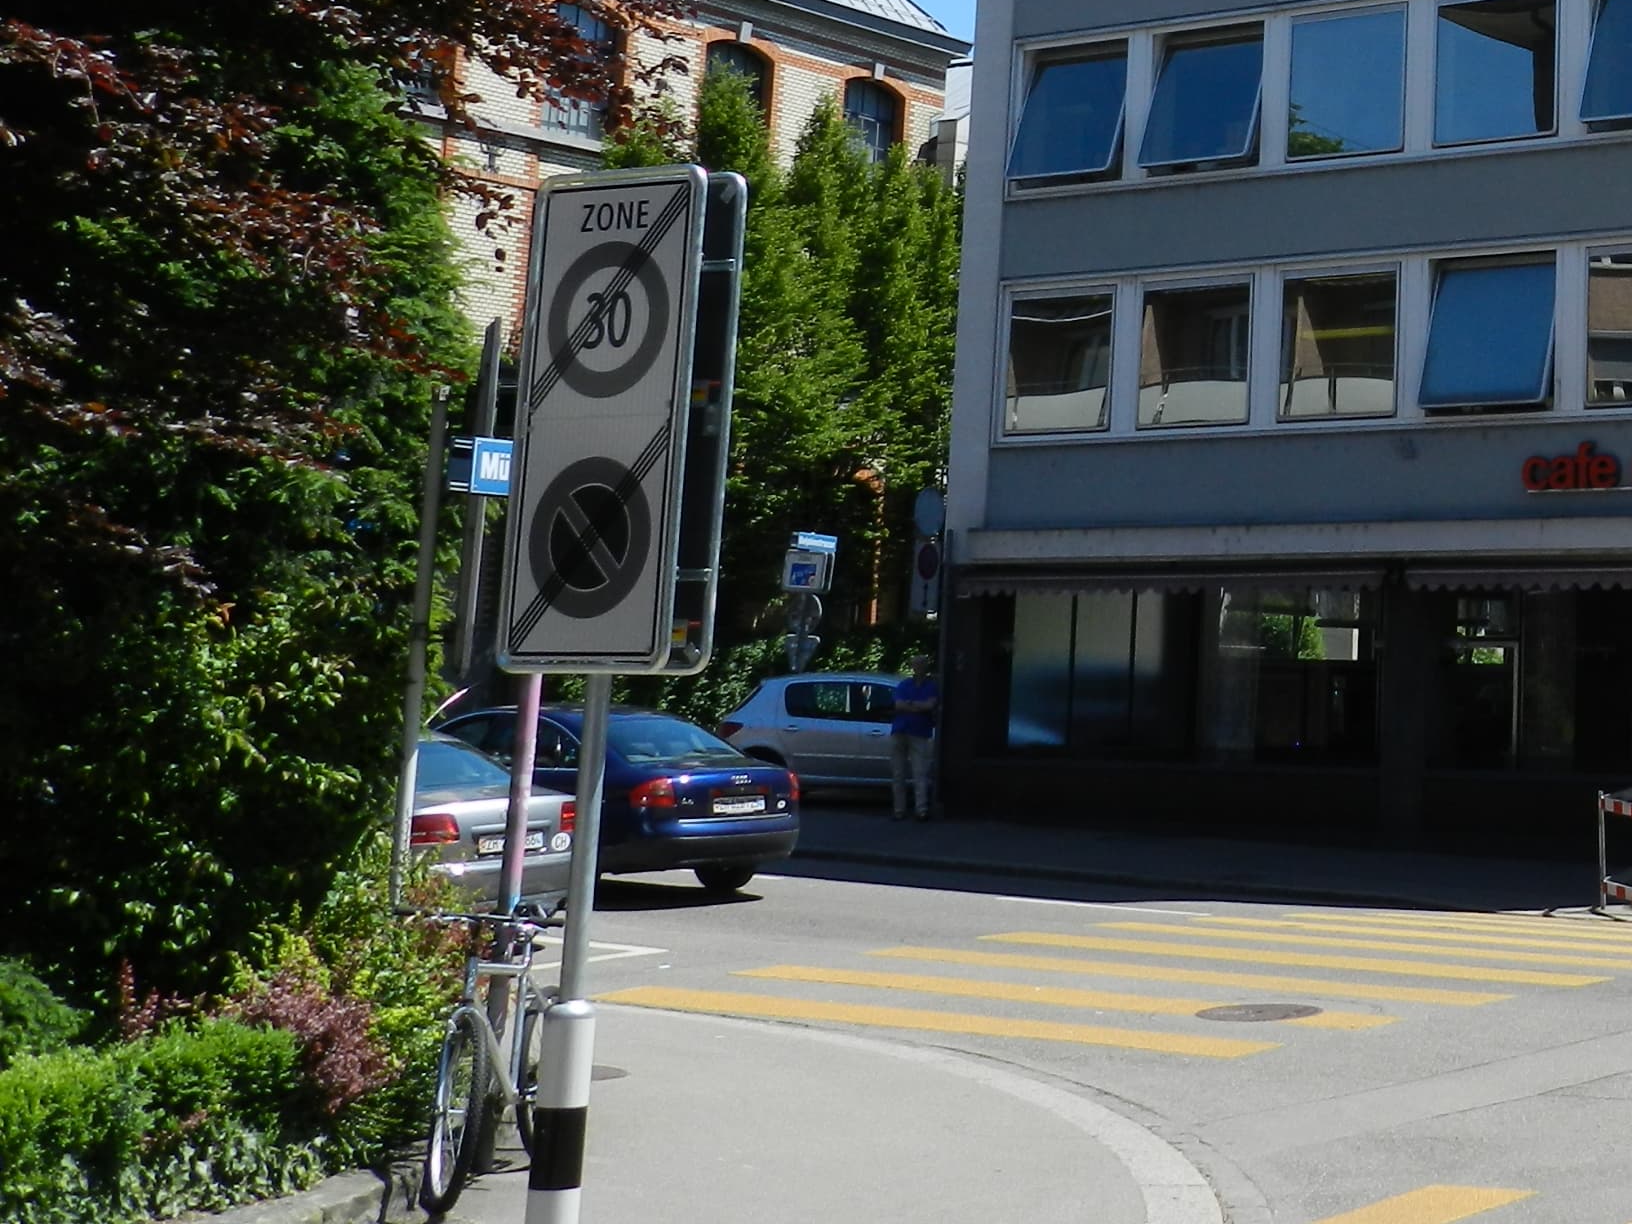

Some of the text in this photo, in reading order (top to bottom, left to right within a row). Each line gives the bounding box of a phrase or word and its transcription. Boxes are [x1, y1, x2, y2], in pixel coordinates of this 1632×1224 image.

[580, 200, 650, 233] ZONE
[582, 291, 632, 350] 30
[480, 450, 512, 481] Mü
[1521, 440, 1621, 492] cafe
[555, 836, 567, 849] CH
